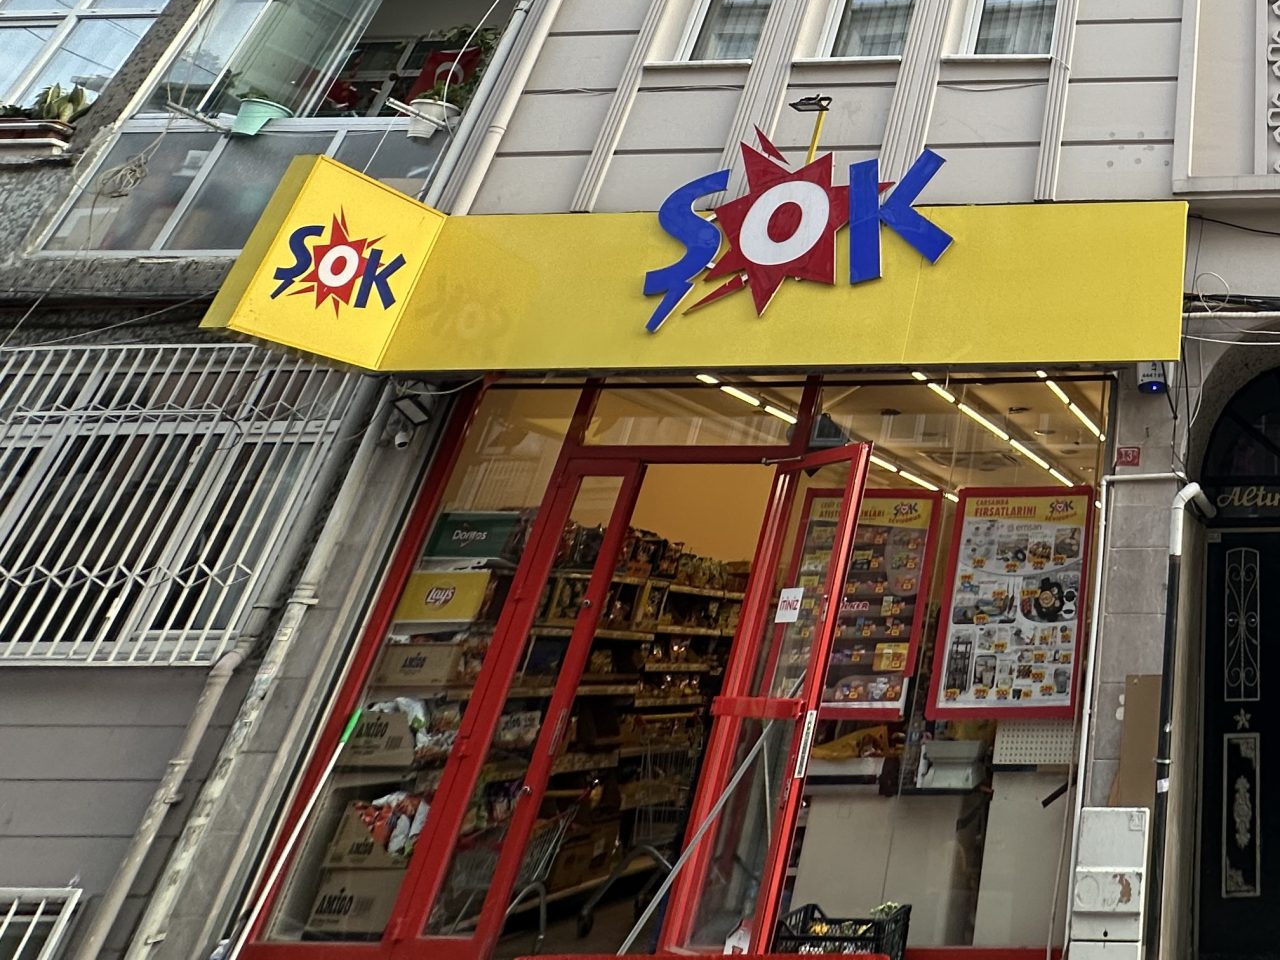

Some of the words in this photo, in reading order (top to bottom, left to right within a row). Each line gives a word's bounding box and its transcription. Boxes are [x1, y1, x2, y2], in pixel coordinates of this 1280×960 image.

[643, 148, 954, 333] ŞOK
[270, 224, 406, 310] ŞOK
[974, 505, 1037, 518] FIRSATLARINI
[452, 529, 488, 541] Doritos
[426, 586, 455, 606] Lay's
